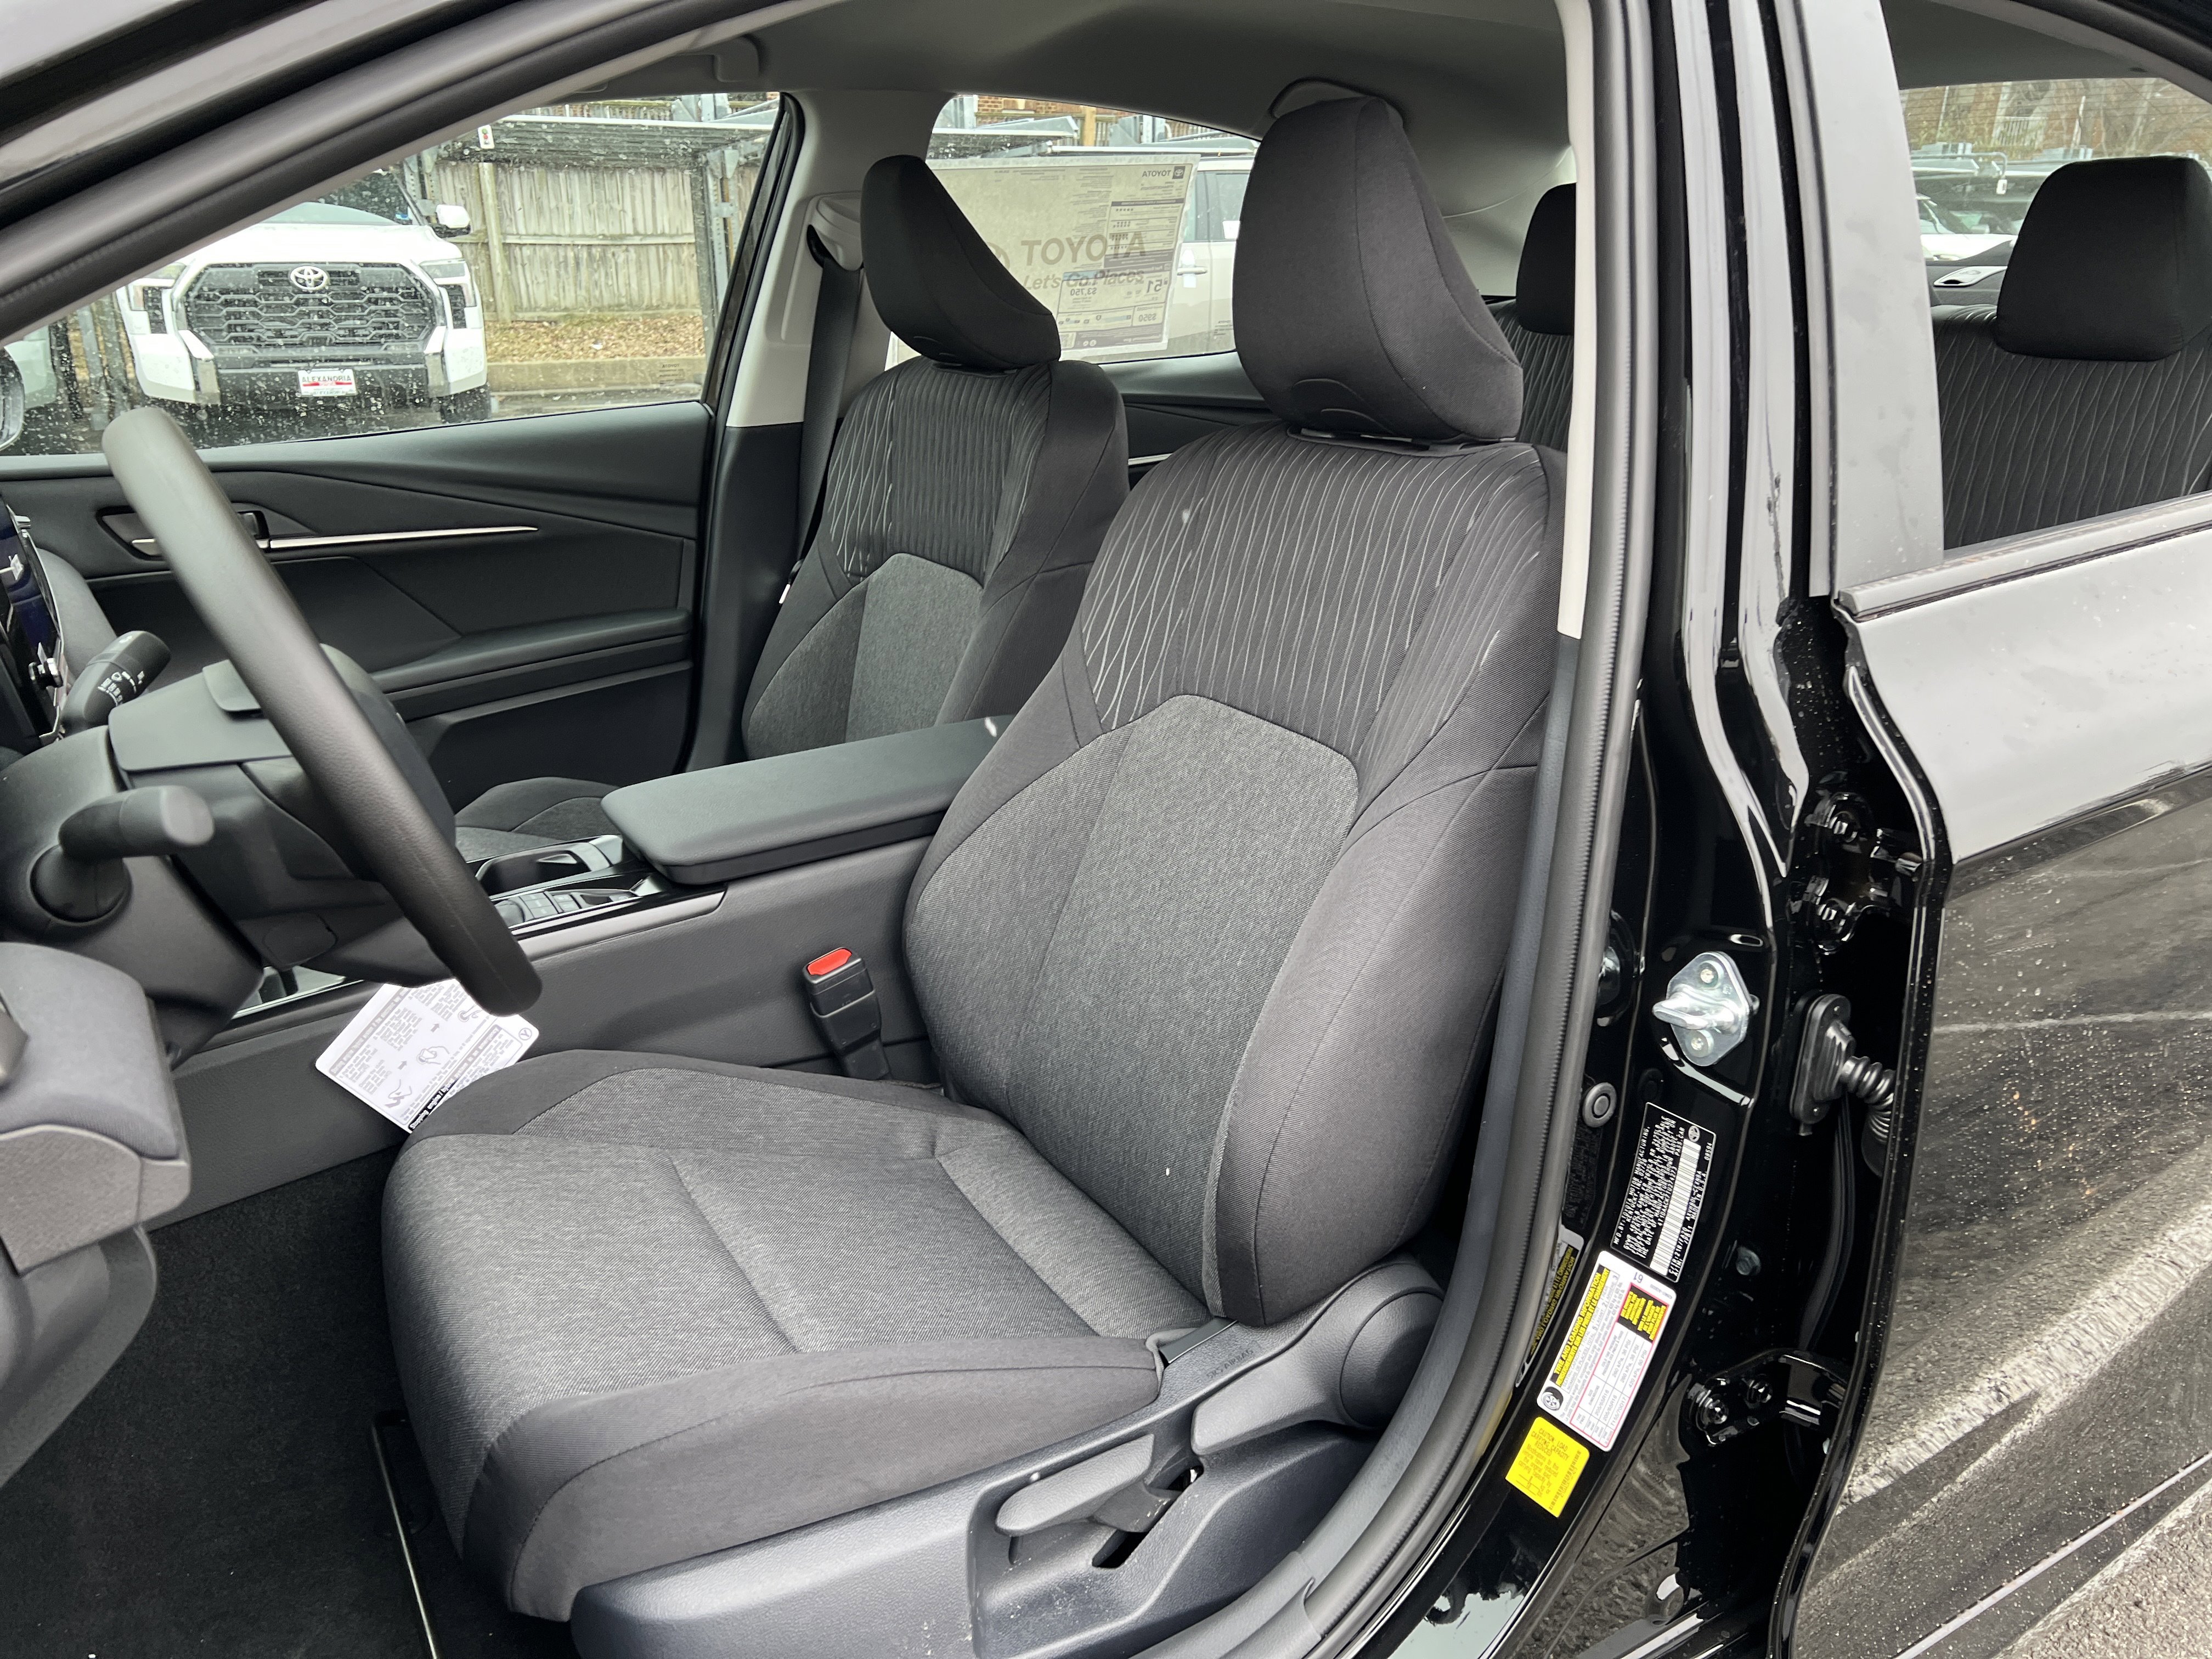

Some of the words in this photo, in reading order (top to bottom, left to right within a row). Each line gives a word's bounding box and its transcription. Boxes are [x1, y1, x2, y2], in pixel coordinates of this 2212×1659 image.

[1021, 232, 1146, 266] TOYOTA
[1024, 274, 1061, 290] Let's
[1066, 272, 1088, 287] Go
[1094, 269, 1144, 285] Places
[1593, 1268, 1610, 1300] CHARGEMENT
[1633, 1271, 1644, 1284] 61
[1590, 1297, 1598, 1306] LE
[1553, 1357, 1566, 1375] TIRE
[1560, 1344, 1571, 1359] AND
[1566, 1315, 1584, 1346] LOADING
[1579, 1272, 1601, 1317] INFORMATION
[1530, 1430, 1550, 1447] CARRYING
[1550, 1444, 1569, 1461] CAPACITY
[1556, 1440, 1568, 1452] LOAD
